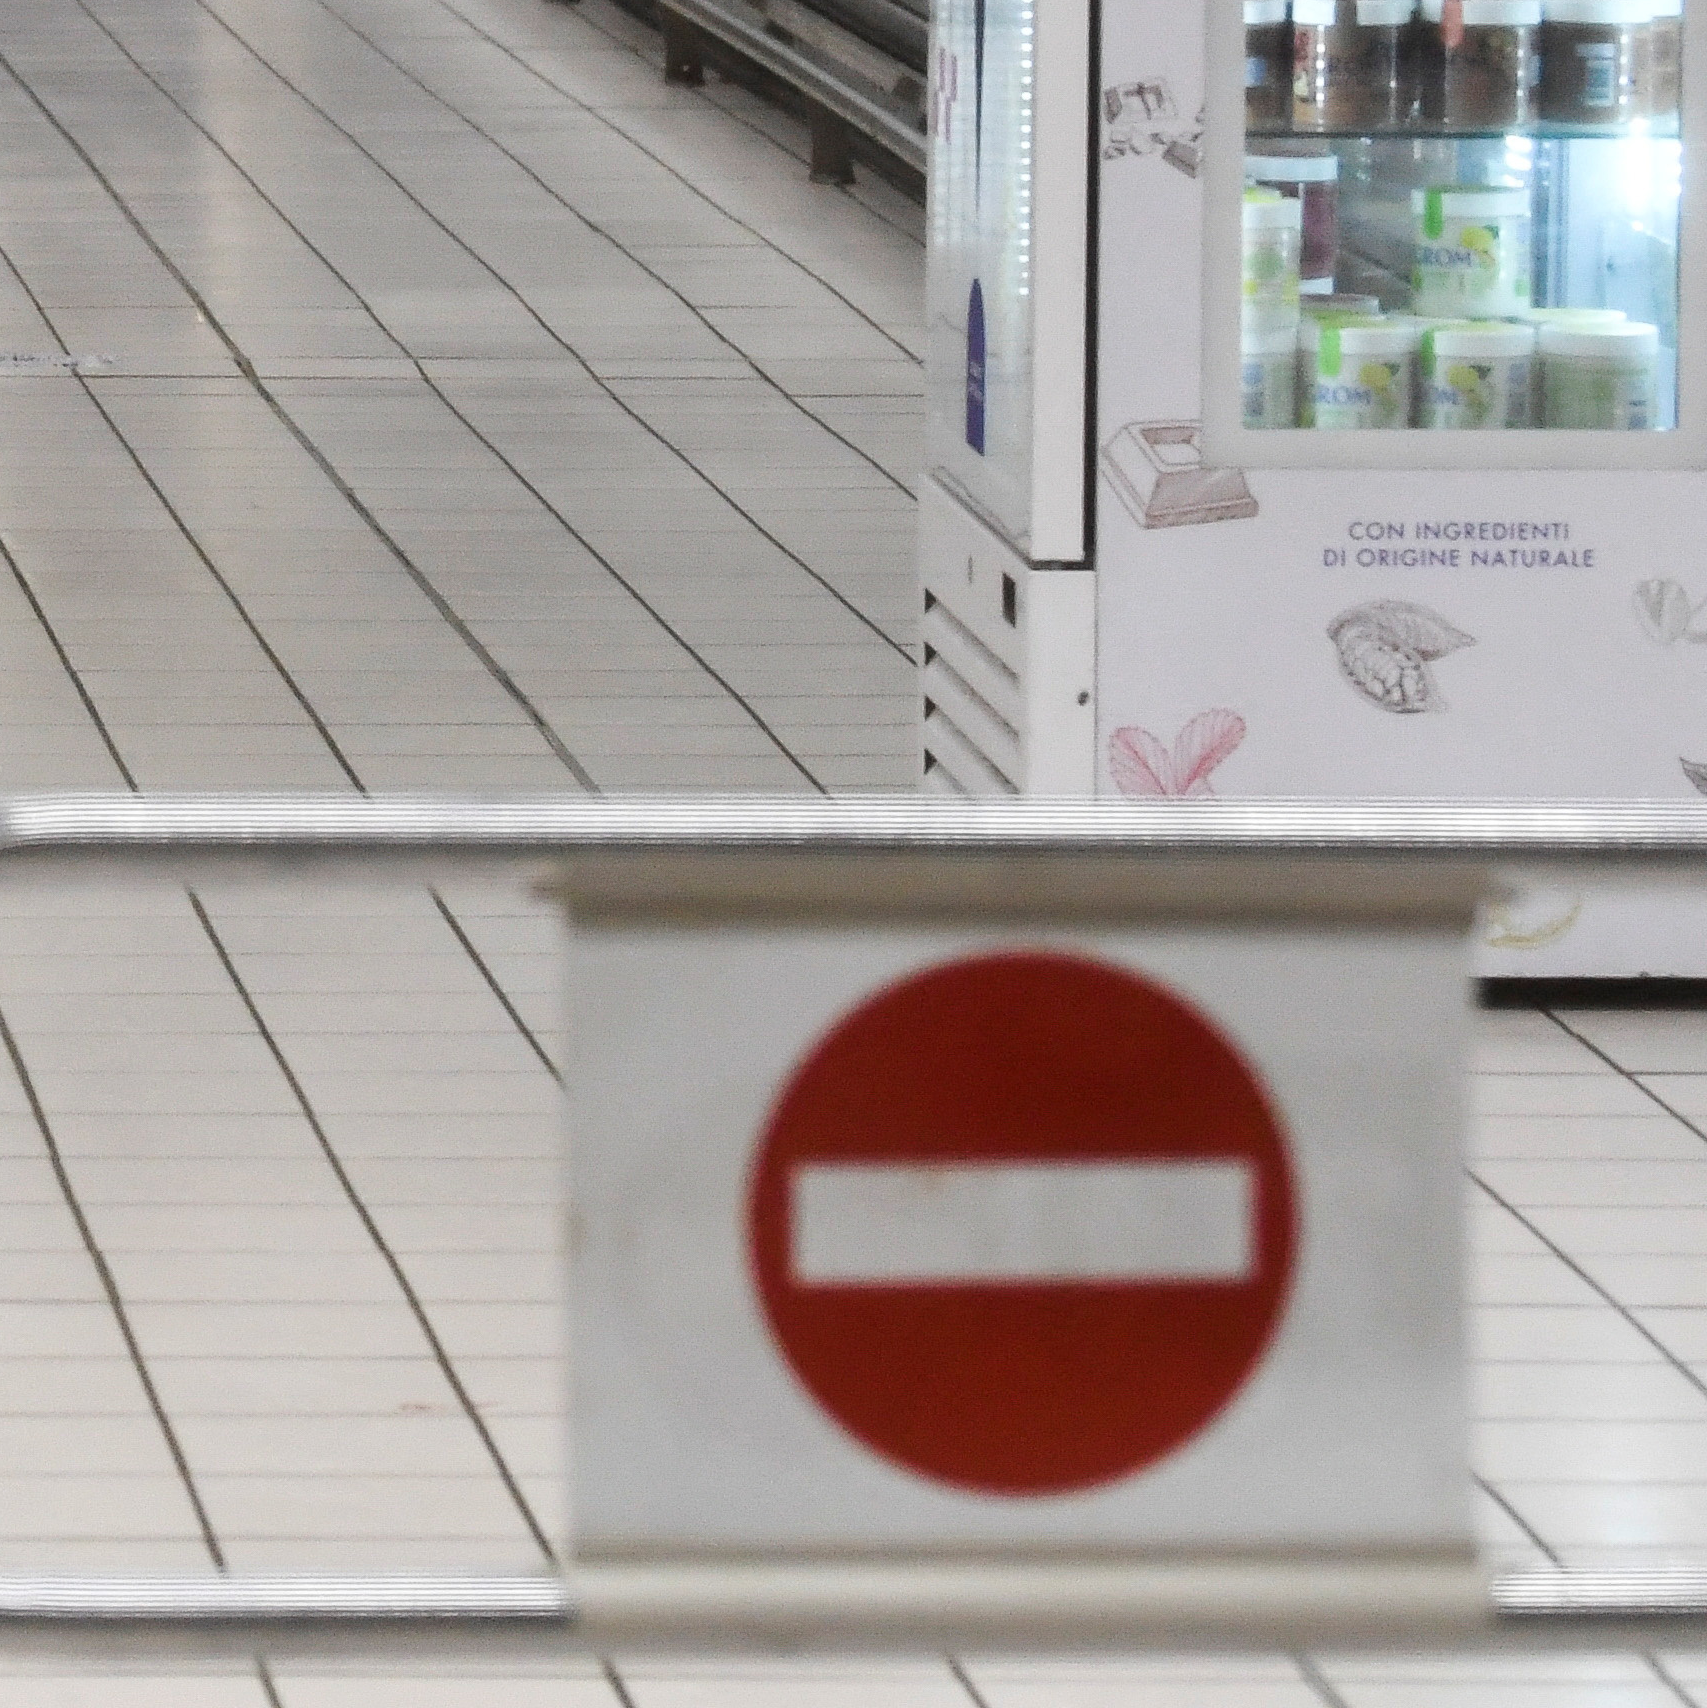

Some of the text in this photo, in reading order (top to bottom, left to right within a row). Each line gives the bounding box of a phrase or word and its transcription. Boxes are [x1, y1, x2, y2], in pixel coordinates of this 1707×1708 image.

[1348, 521, 1571, 542] CON INGREDIENTI
[1323, 548, 1595, 568] DI ORIGINE NATURALE
